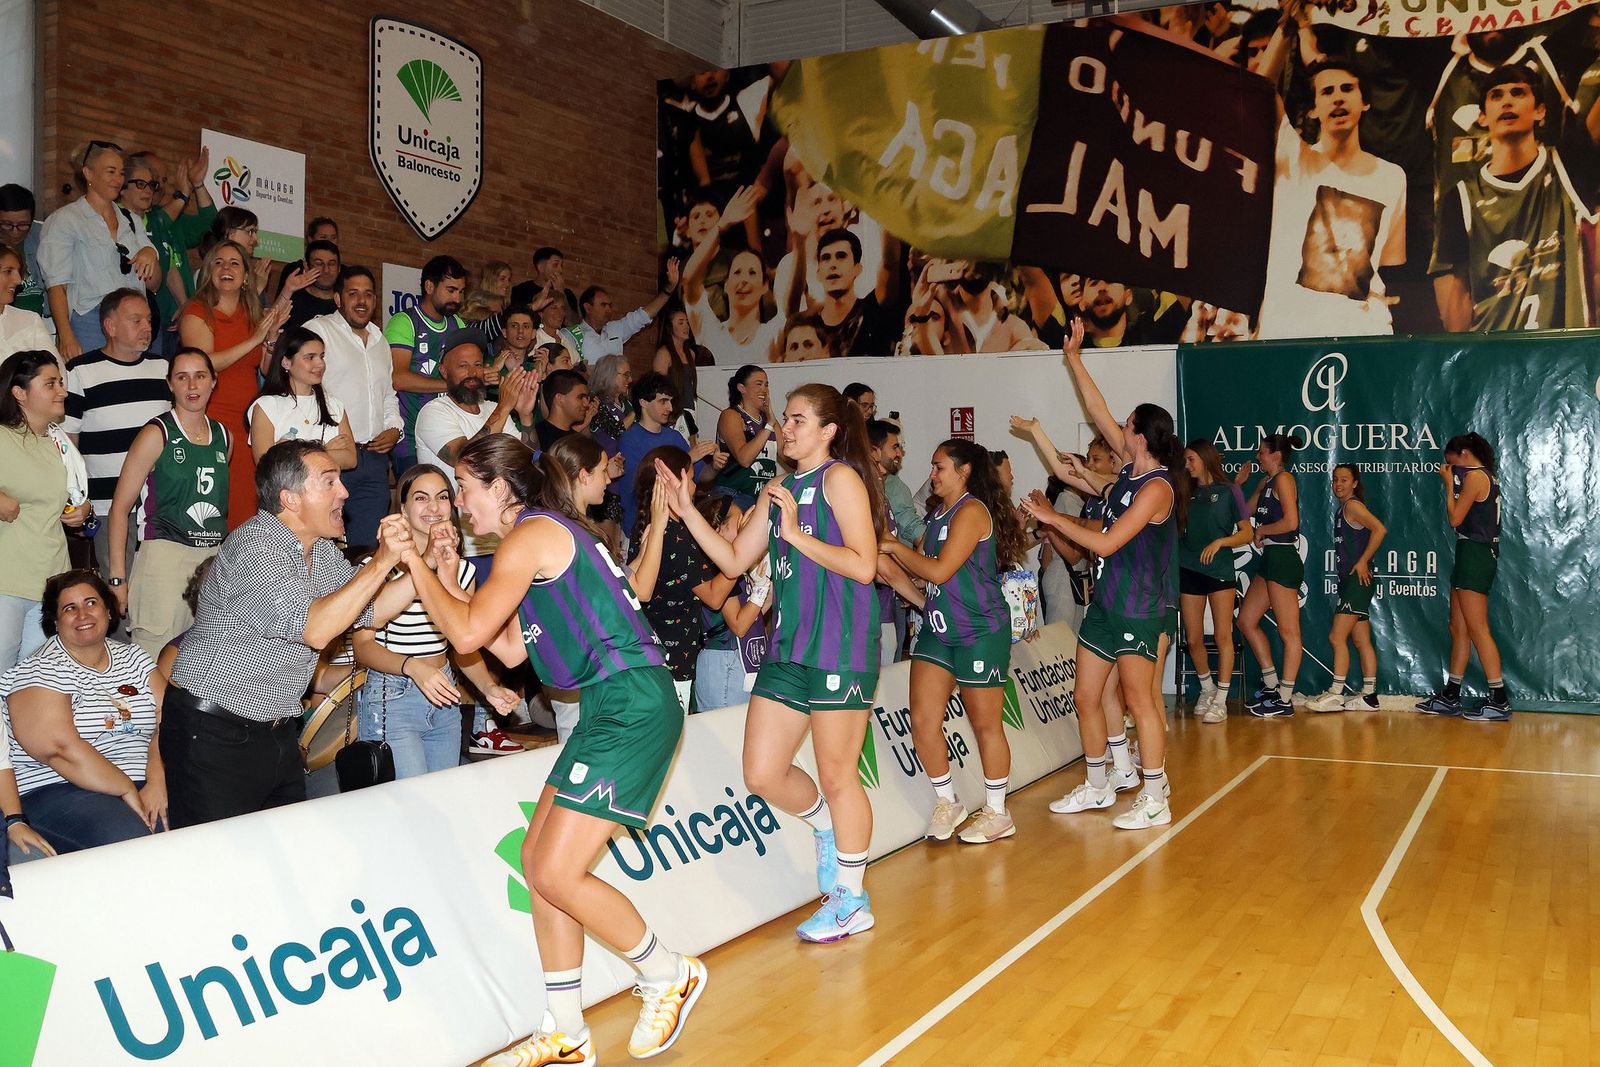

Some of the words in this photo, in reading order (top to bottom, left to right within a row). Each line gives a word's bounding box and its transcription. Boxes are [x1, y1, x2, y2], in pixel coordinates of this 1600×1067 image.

[398, 124, 460, 162] Unicaja
[397, 155, 461, 183] Baloncesto
[389, 290, 422, 316] JO
[196, 466, 215, 495] 15
[1355, 462, 1441, 475] TRIBUTARIOS
[1376, 584, 1383, 599] y
[1389, 580, 1437, 597] Eventos
[606, 786, 781, 881] Unicaja
[94, 898, 437, 1060] Unicaja
